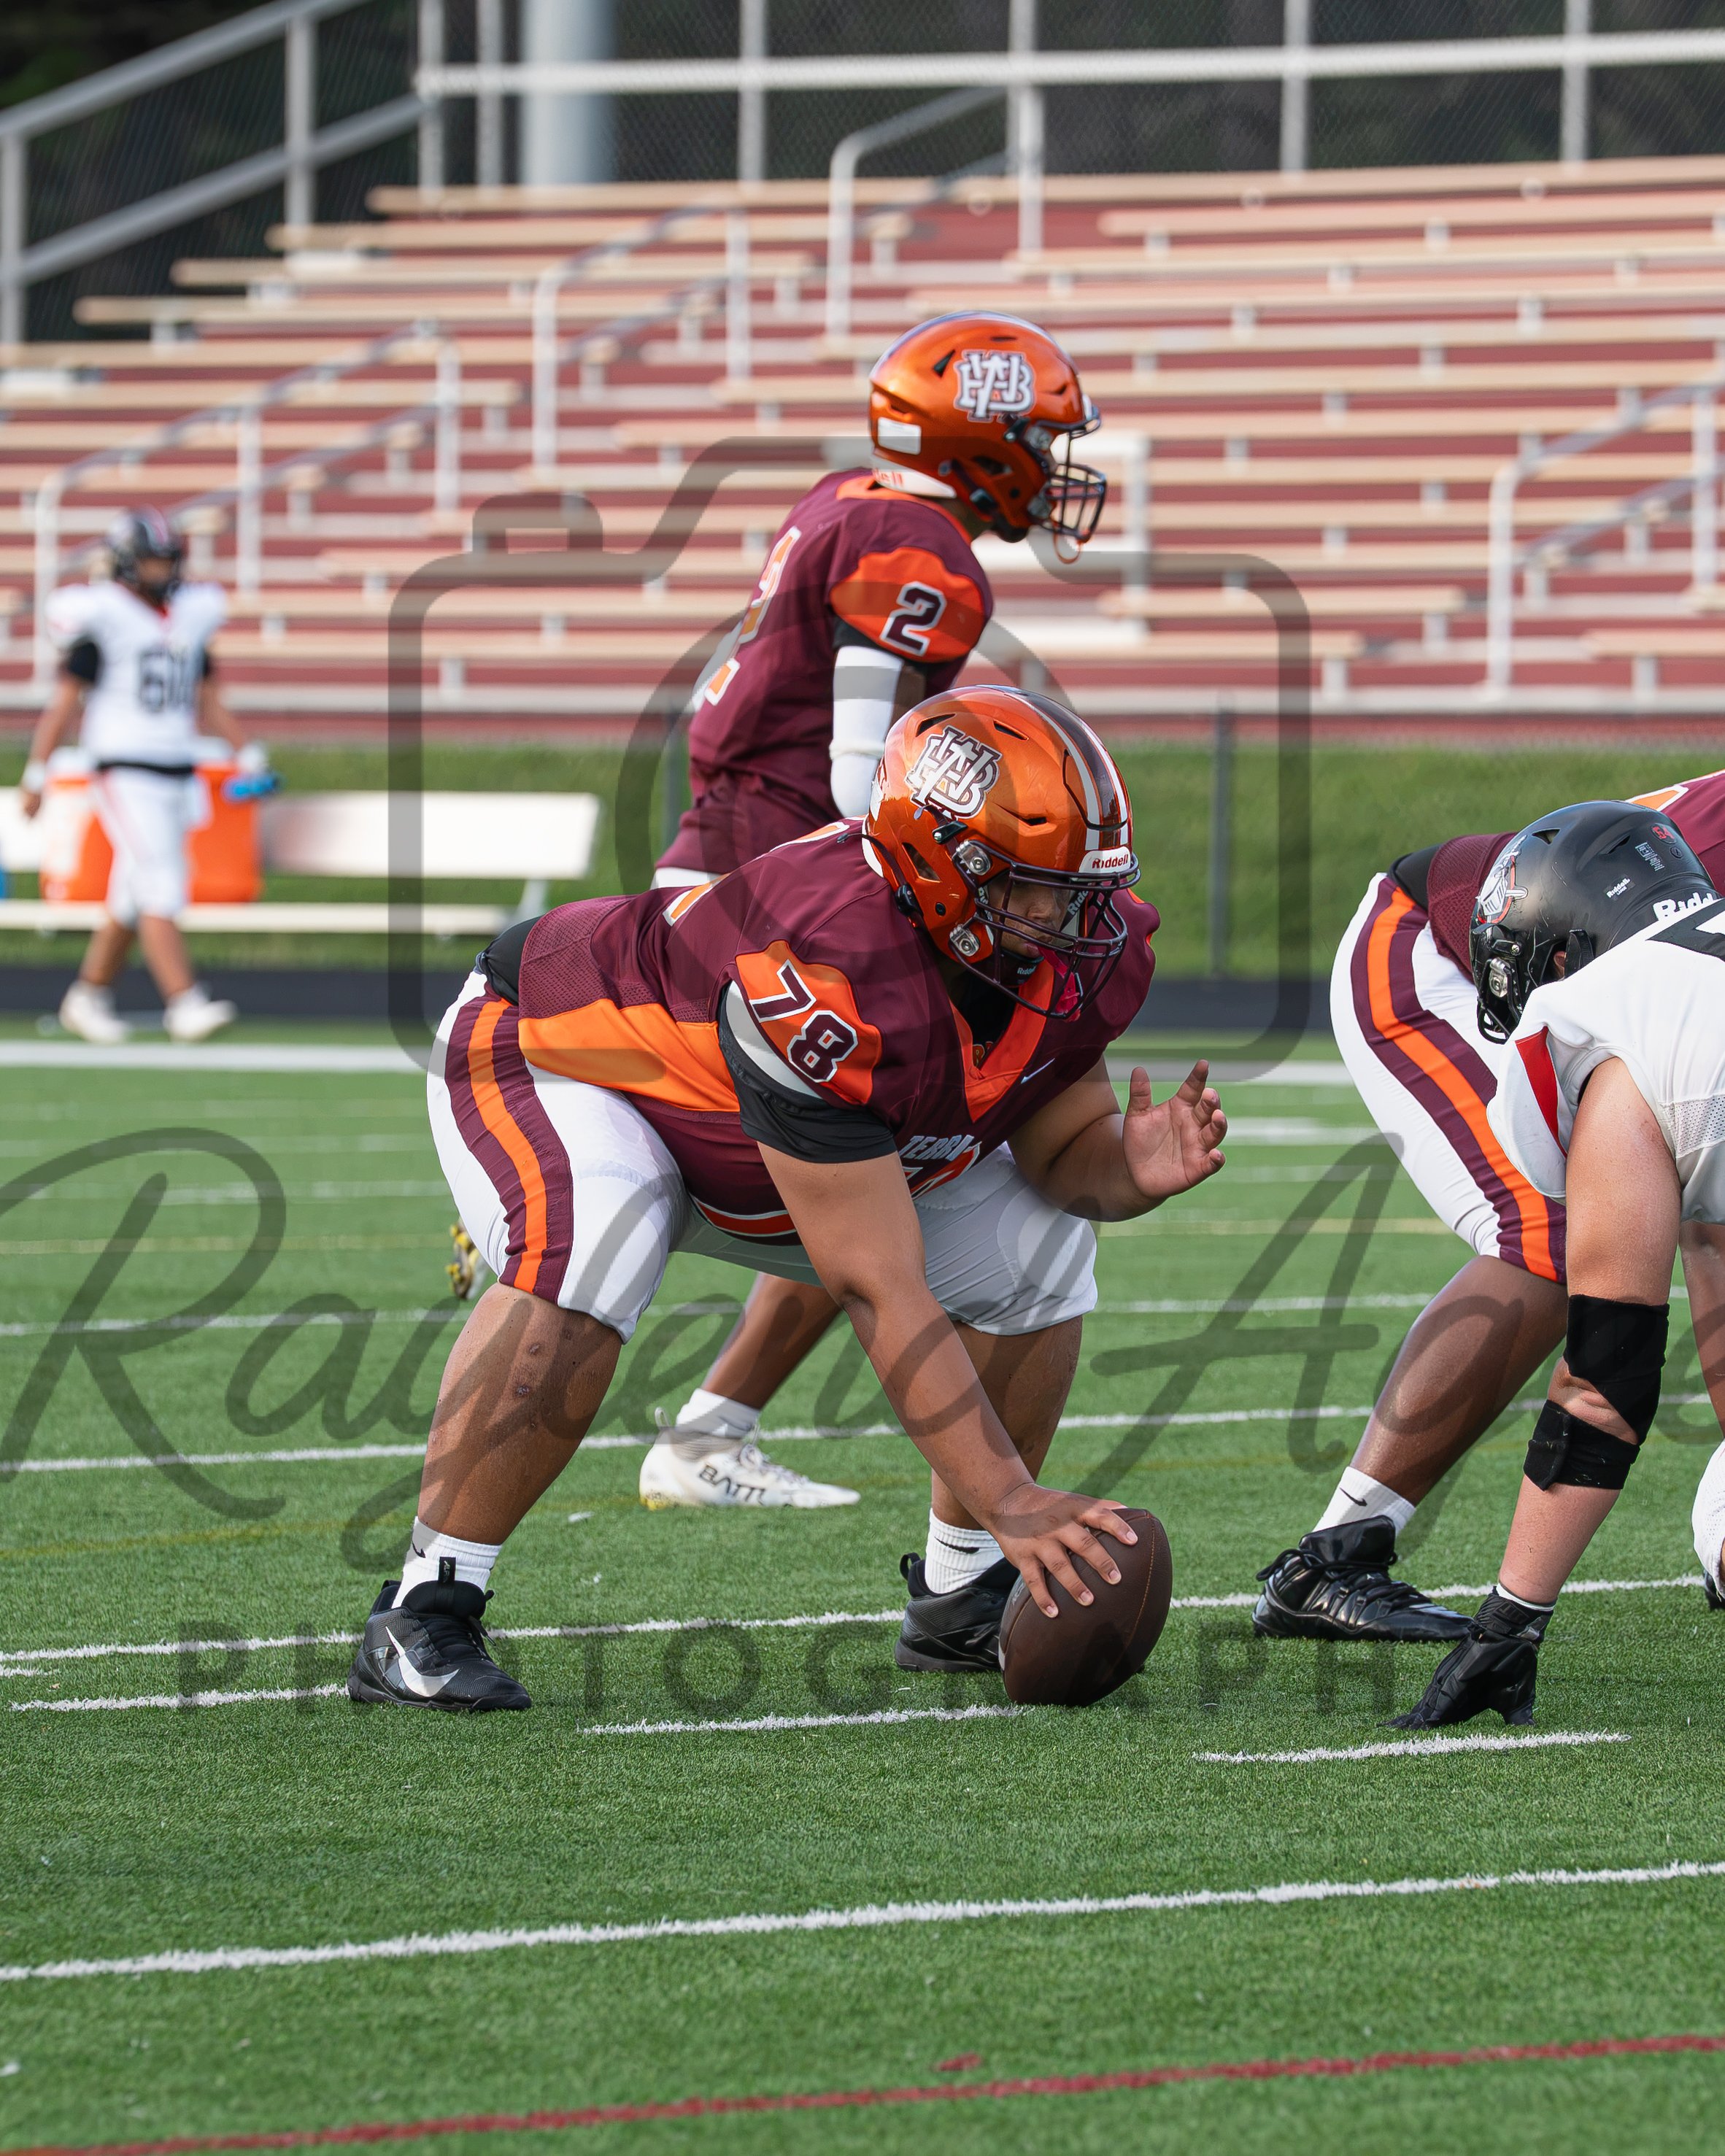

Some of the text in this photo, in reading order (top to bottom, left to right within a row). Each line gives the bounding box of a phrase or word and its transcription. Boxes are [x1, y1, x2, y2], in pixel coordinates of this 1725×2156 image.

[879, 581, 947, 656] 2
[1092, 854, 1129, 869] Riddell
[1606, 878, 1631, 898] Riddell
[749, 959, 859, 1083] 78
